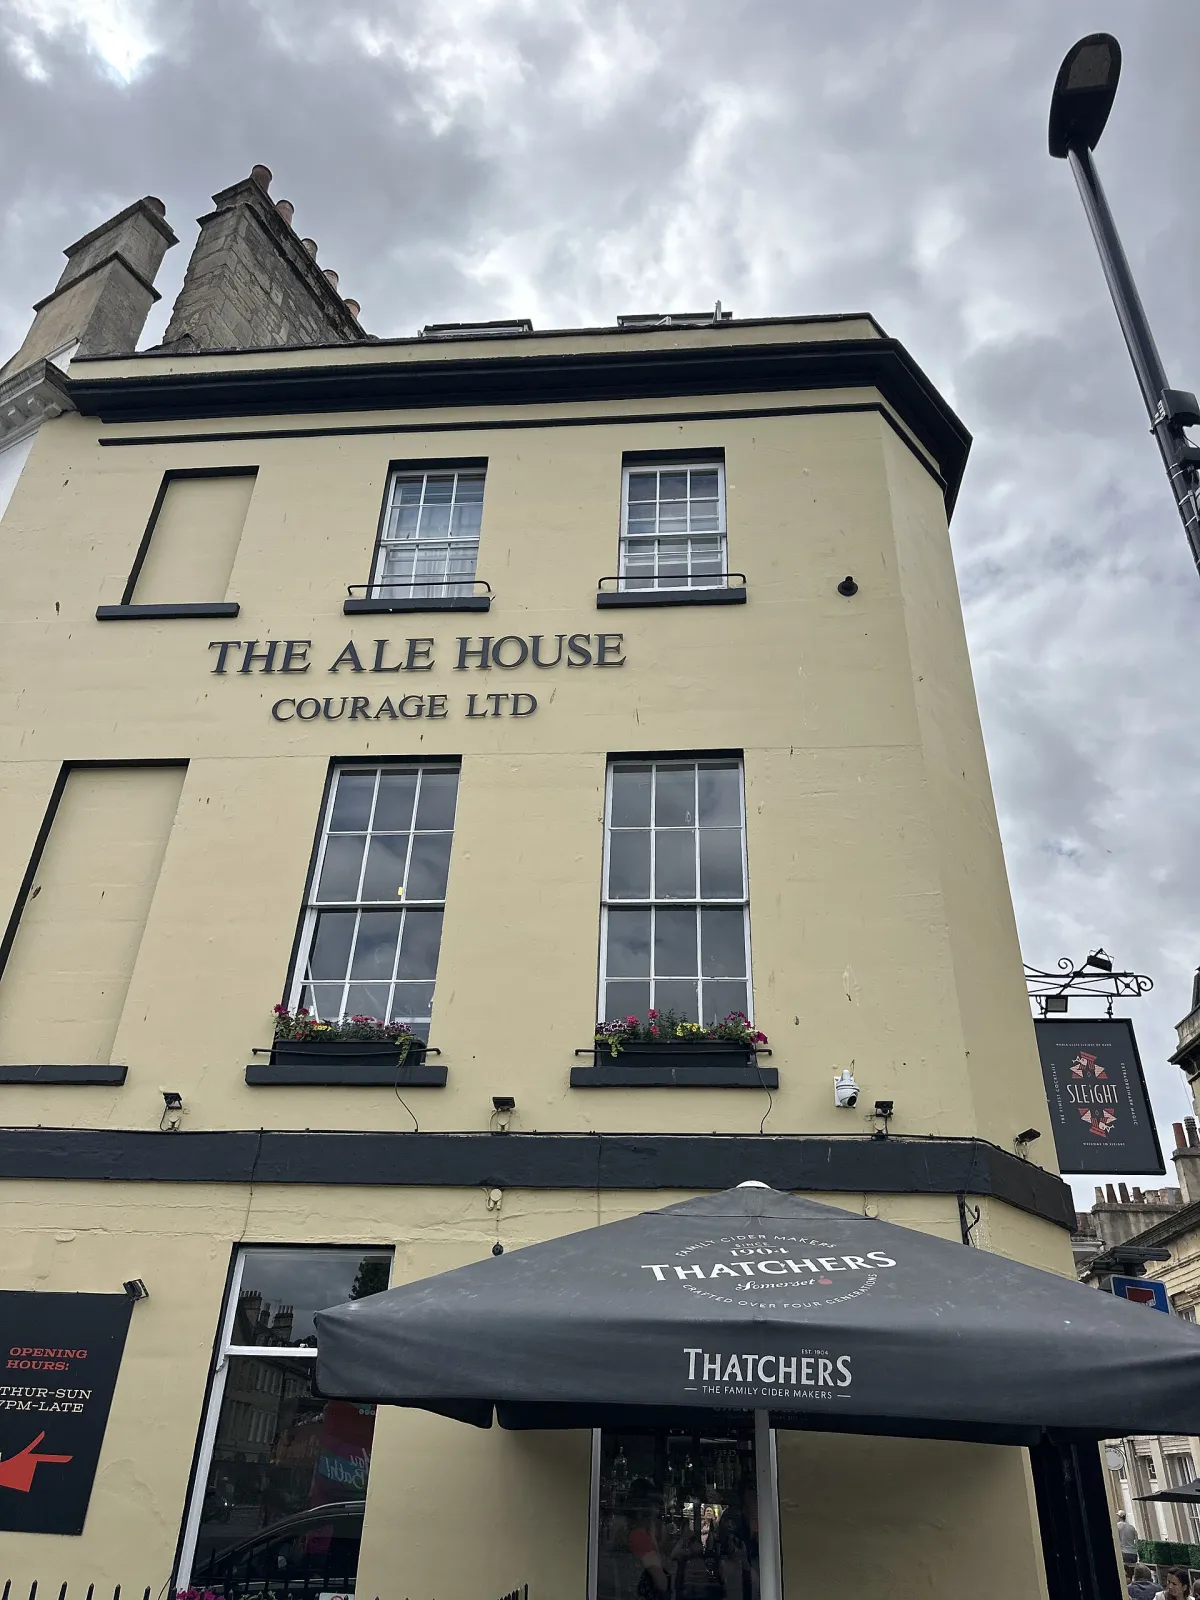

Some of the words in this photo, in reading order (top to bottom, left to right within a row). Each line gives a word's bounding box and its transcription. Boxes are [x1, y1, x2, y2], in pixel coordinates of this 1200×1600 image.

[208, 638, 312, 674] THE
[327, 637, 436, 672] ALE
[453, 633, 627, 670] HOUSE
[271, 694, 449, 722] COURAGE
[465, 692, 538, 718] LTD
[1050, 1063, 1060, 1093] COCKTAILS
[1120, 1062, 1134, 1106] EXTRAORDINARY
[1130, 1107, 1138, 1126] MAGIC
[675, 1240, 715, 1257] FAMILY
[720, 1234, 767, 1243] CIDER
[774, 1235, 837, 1248] MAKERS
[730, 1246, 789, 1257] 1904
[641, 1251, 897, 1281] THATCHERS
[682, 1284, 733, 1303] CRAFTED
[738, 1300, 776, 1309] OVER
[783, 1301, 823, 1309] FOUR
[825, 1273, 878, 1305] GENERATIONS
[735, 1278, 816, 1291] Somerset
[6, 1359, 70, 1371] HOURS:
[9, 1346, 88, 1359] OPENING
[683, 1348, 853, 1387] THATCHERS
[0, 1387, 92, 1400] THUR-SUN
[702, 1385, 721, 1394] THE
[724, 1386, 758, 1395] FAMILY
[761, 1387, 790, 1397] CIDER
[793, 1389, 833, 1400] MAKERS
